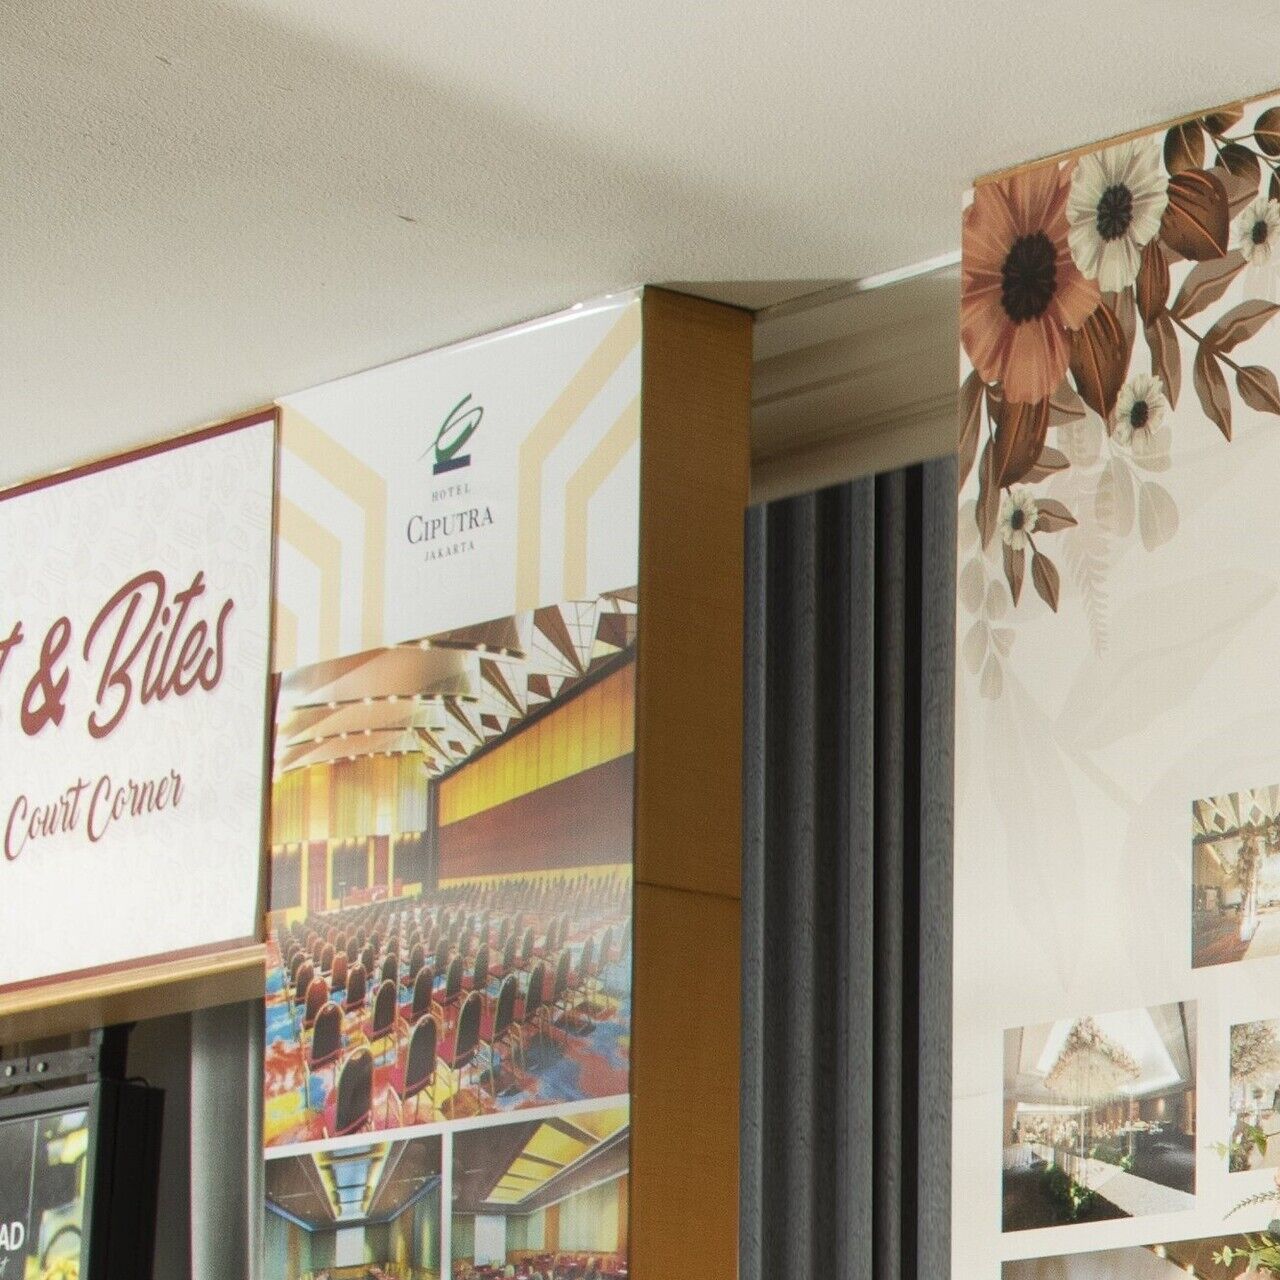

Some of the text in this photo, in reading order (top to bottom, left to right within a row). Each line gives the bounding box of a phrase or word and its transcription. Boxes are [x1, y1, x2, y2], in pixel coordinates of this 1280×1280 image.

[431, 483, 471, 502] HOTEL
[406, 506, 494, 545] CIPUTRA
[424, 540, 475, 562] JAKARTA
[83, 569, 235, 740] Bites
[4, 768, 184, 861] Court Corner
